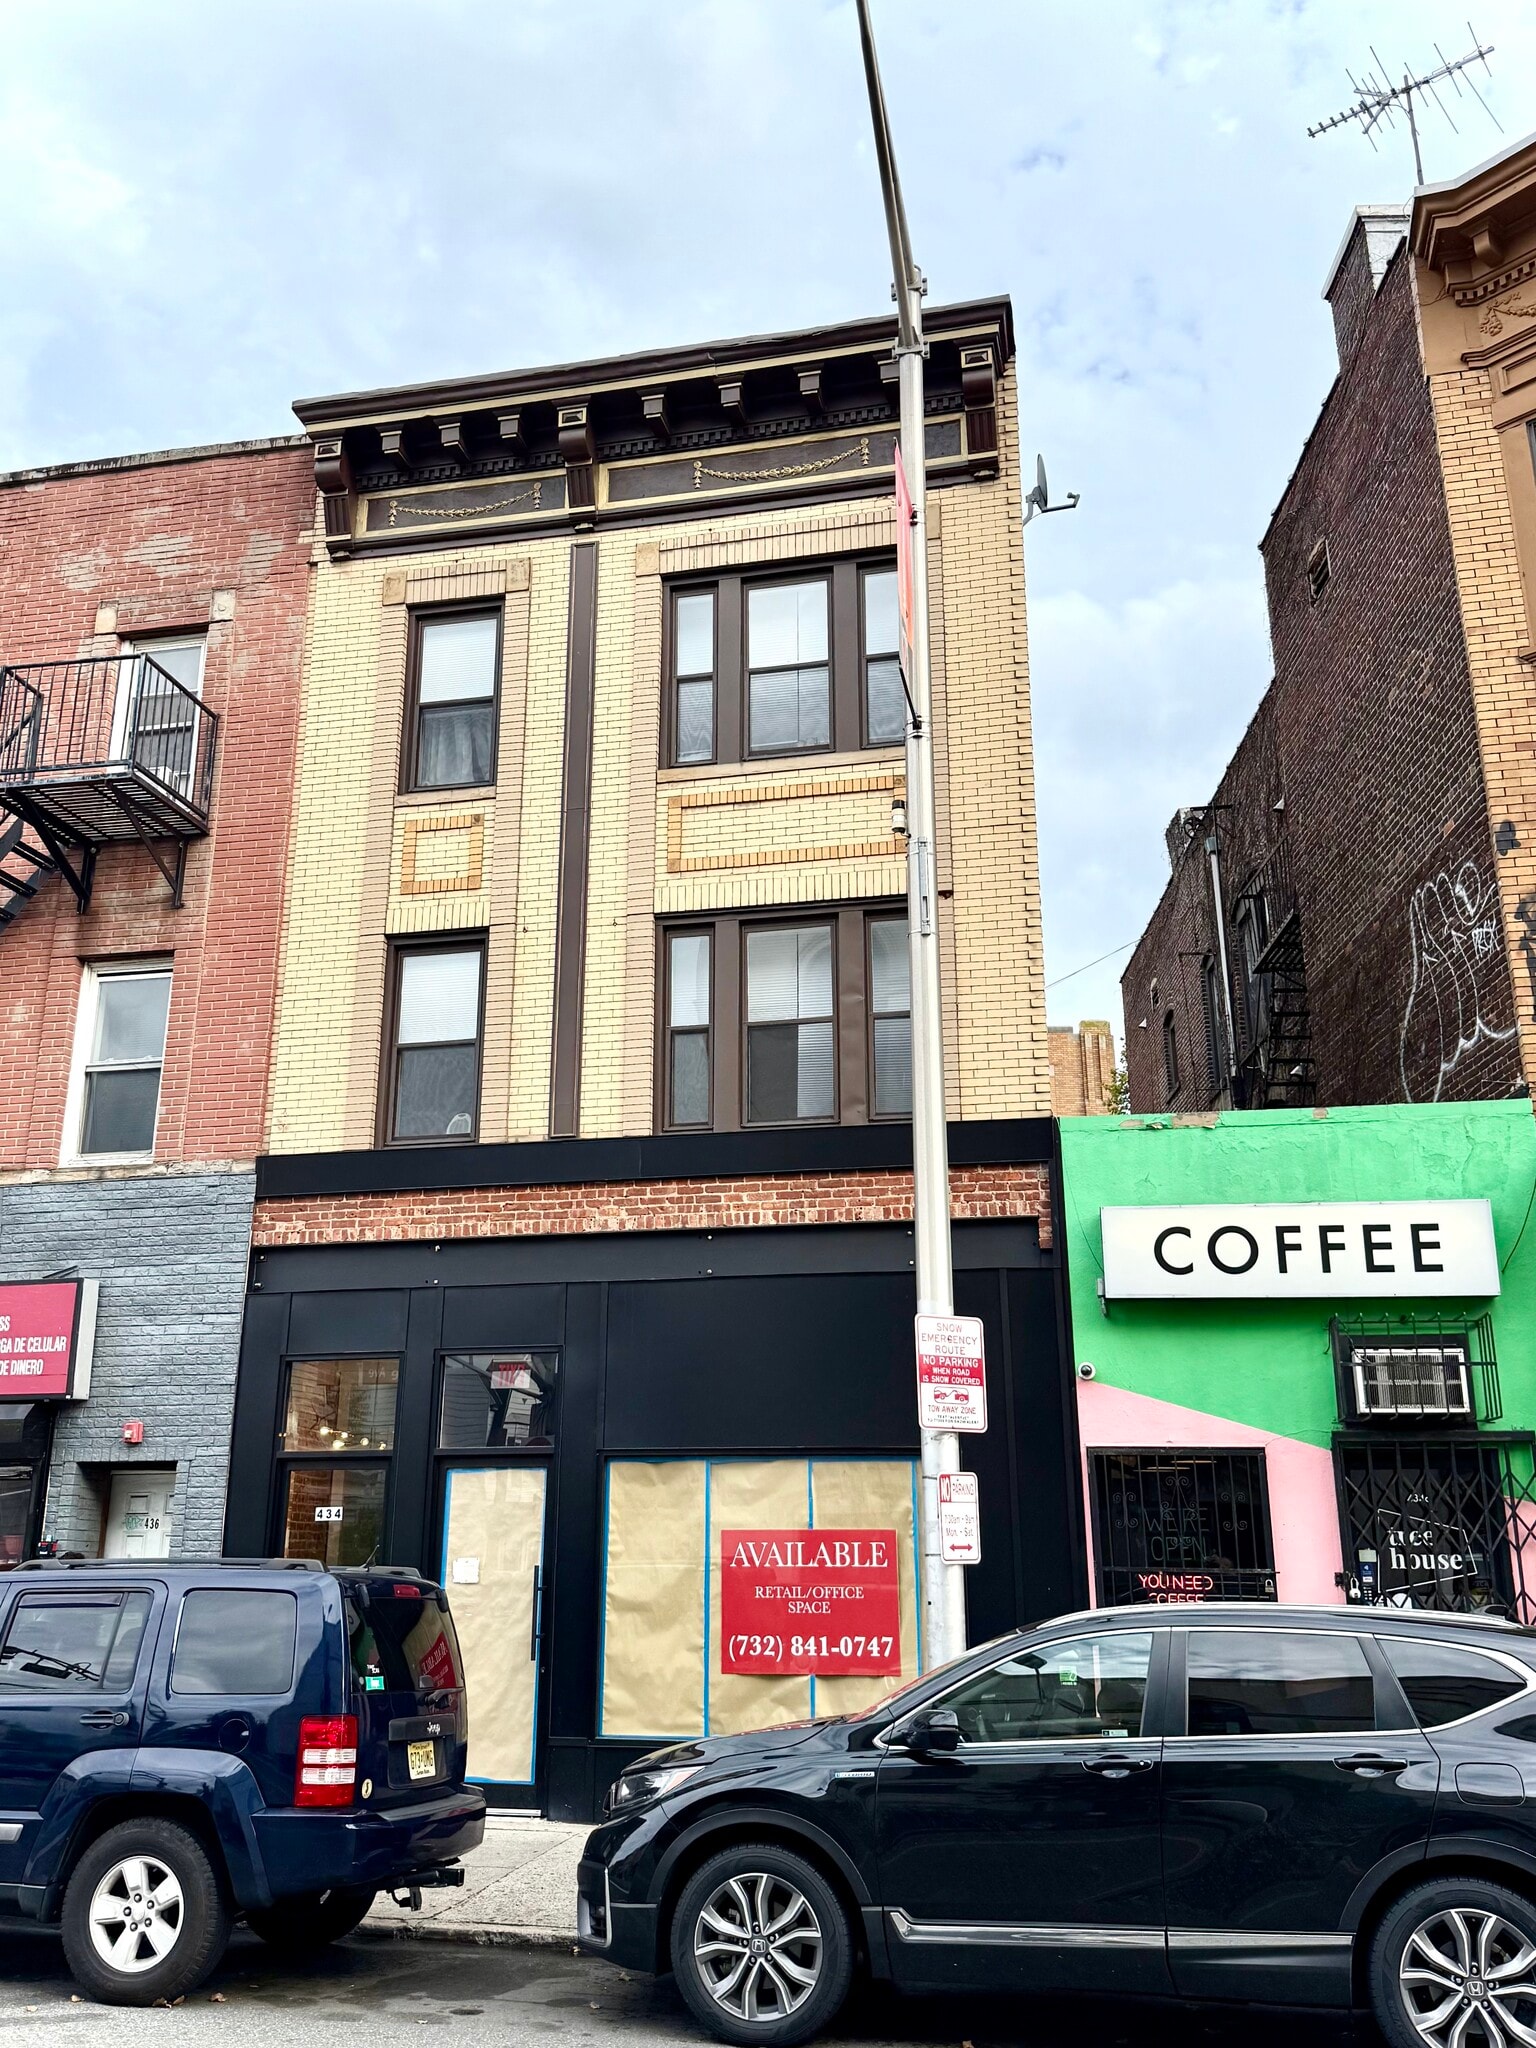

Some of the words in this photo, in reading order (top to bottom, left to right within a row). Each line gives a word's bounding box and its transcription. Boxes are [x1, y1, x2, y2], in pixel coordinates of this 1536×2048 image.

[1154, 1223, 1443, 1275] COFFEE
[937, 1323, 962, 1332] SNOW
[14, 1337, 26, 1353] DE
[27, 1336, 67, 1352] CELULAR
[921, 1333, 977, 1345] EMERGENCY
[935, 1345, 965, 1355] ROUTE
[10, 1359, 43, 1375] DINERO
[923, 1356, 935, 1364] NO
[940, 1356, 978, 1367] PARKING
[932, 1376, 949, 1384] SNOW
[940, 1476, 951, 1502] NO
[953, 1483, 974, 1495] PARKING
[317, 1509, 341, 1519] 434
[145, 1517, 159, 1529] 436
[730, 1542, 888, 1567] AVAILABLE
[1151, 1536, 1207, 1560] OPEN
[1389, 1547, 1463, 1570] house
[1139, 1573, 1169, 1589] YOU
[1173, 1575, 1213, 1590] NEED
[755, 1586, 864, 1599] RETAIL/OFFICE
[788, 1601, 831, 1614] SPACE
[729, 1635, 783, 1662] (732)
[791, 1636, 893, 1657] 841-0747
[427, 1721, 440, 1735] Jeep
